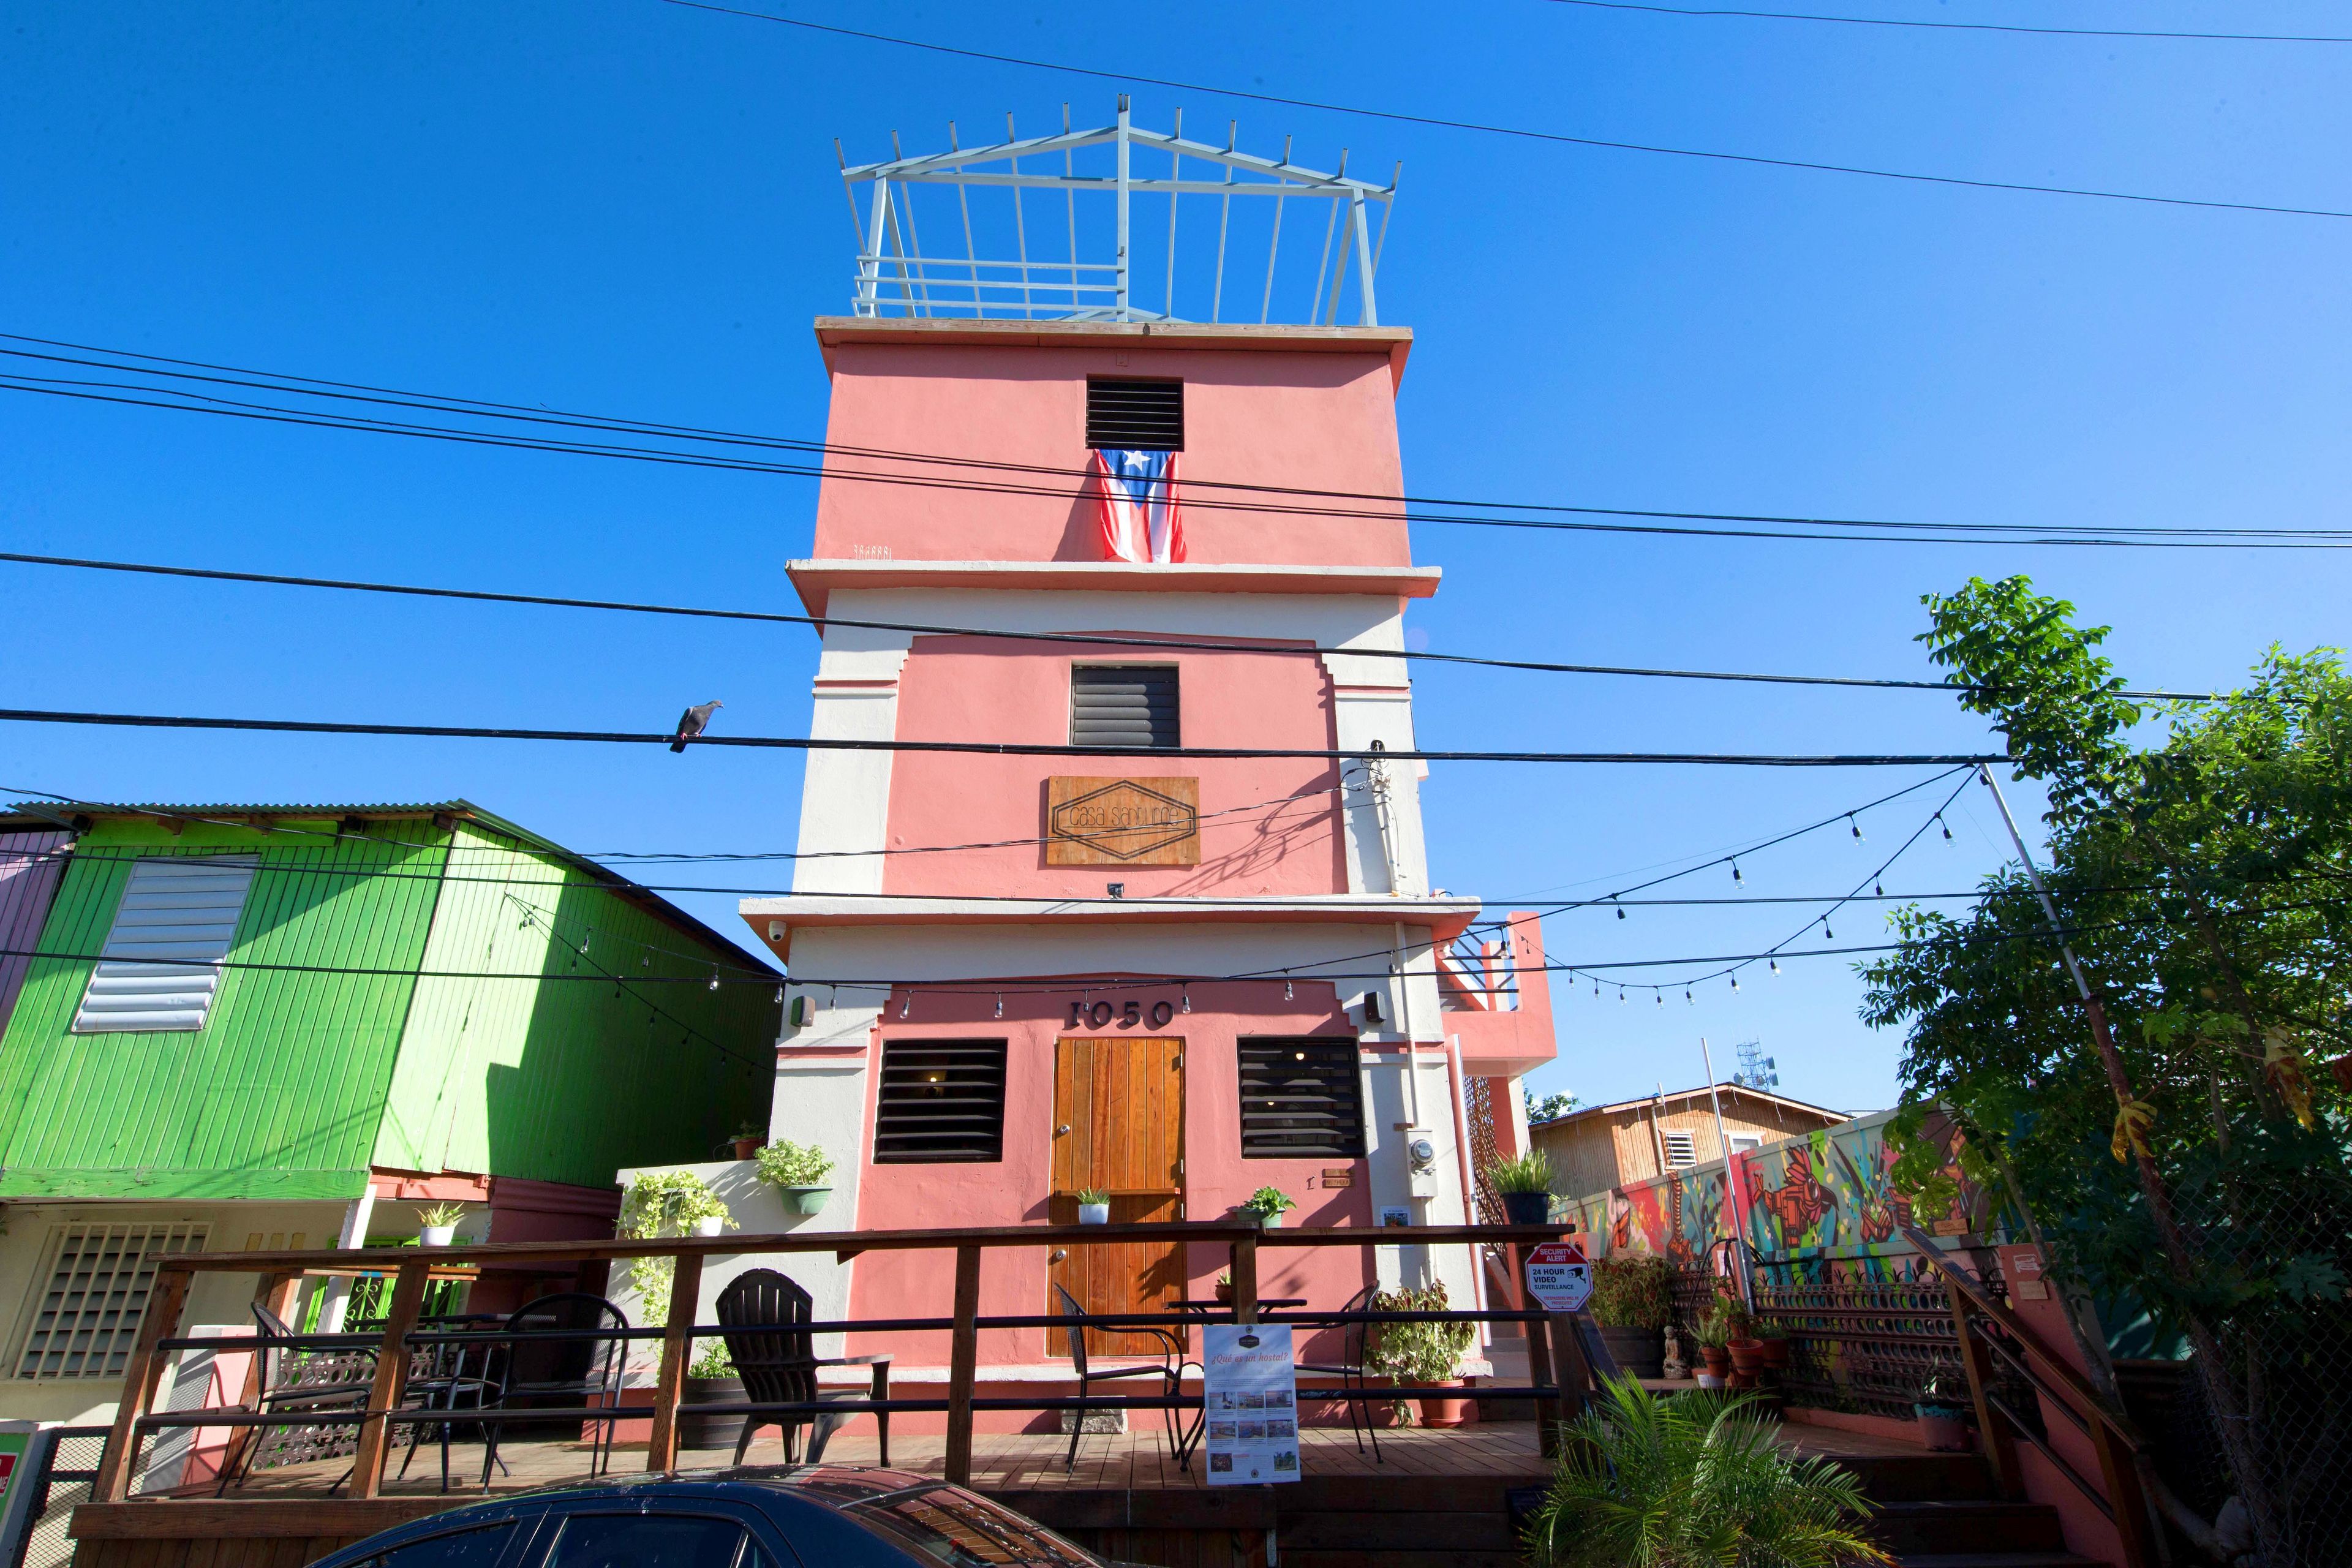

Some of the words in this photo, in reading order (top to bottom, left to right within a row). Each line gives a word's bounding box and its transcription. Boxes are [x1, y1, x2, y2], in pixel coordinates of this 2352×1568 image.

[1071, 1001, 1174, 1026] 1050
[1211, 1354, 1232, 1365] ¿Qué
[1258, 1352, 1289, 1362] hostal?
